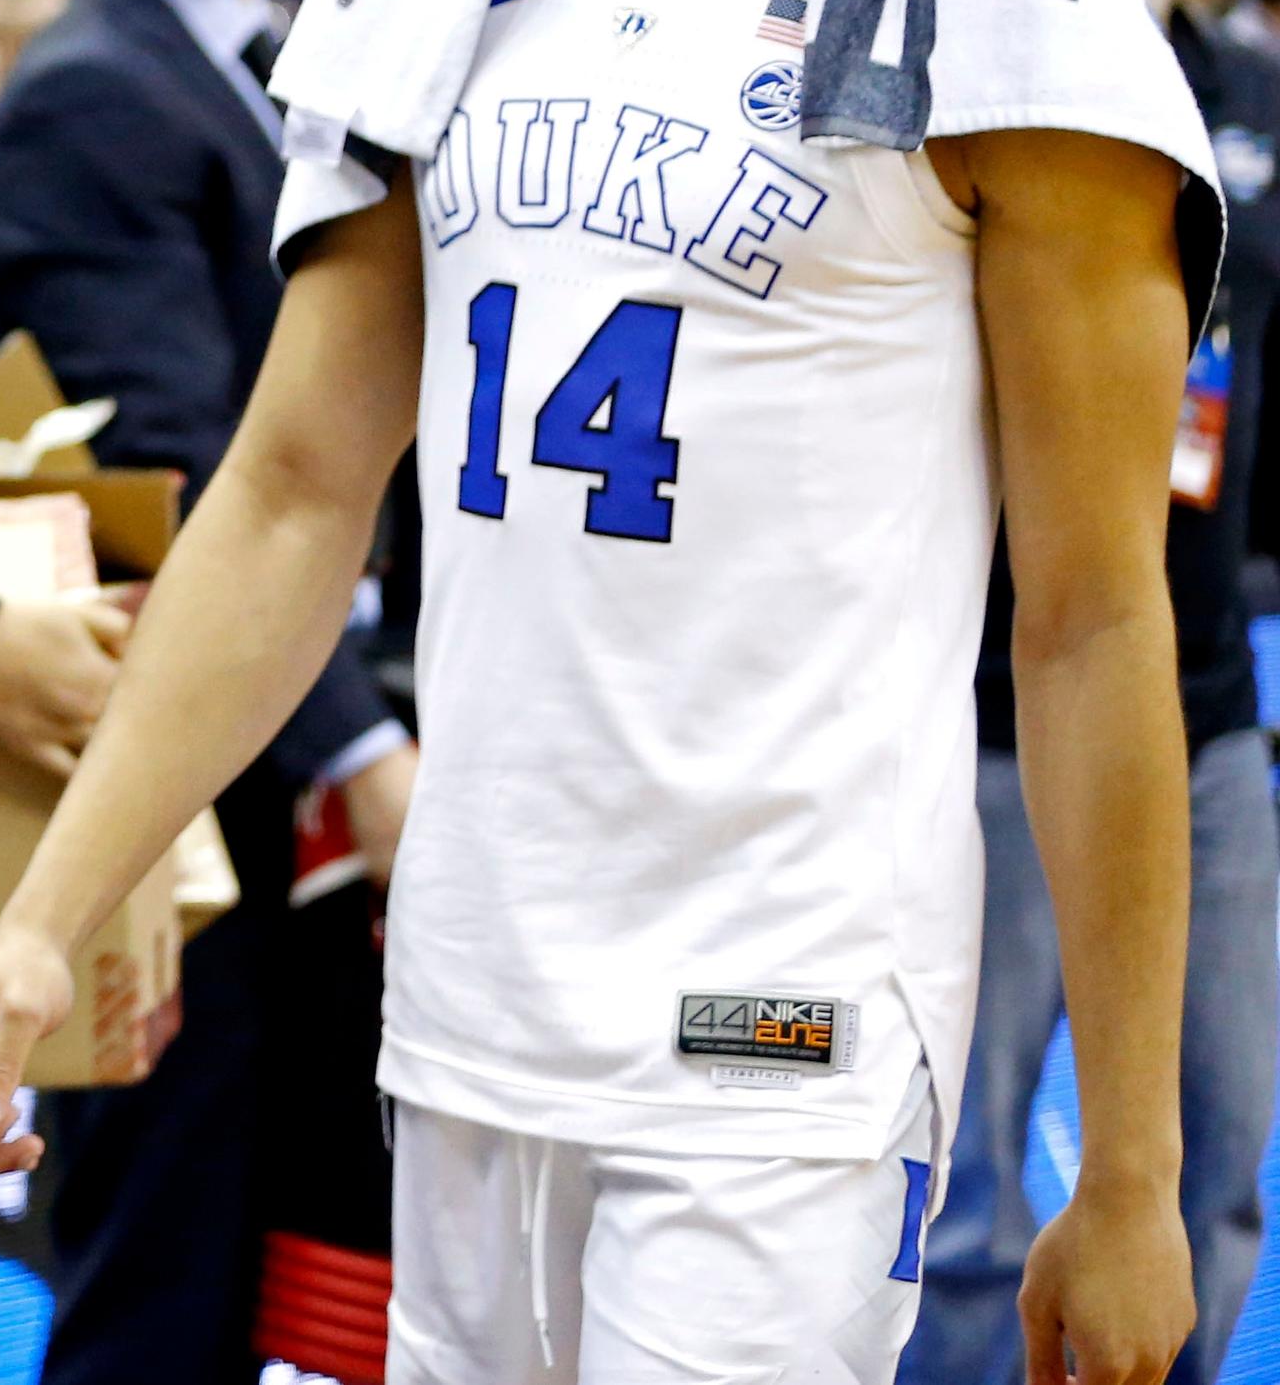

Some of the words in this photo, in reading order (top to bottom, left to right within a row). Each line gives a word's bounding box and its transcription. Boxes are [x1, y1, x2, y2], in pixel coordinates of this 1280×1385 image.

[423, 98, 829, 300] DUKE
[458, 281, 683, 544] 14
[687, 1001, 751, 1035] 44
[756, 1000, 833, 1025] NIKE
[754, 1019, 832, 1047] ELITE
